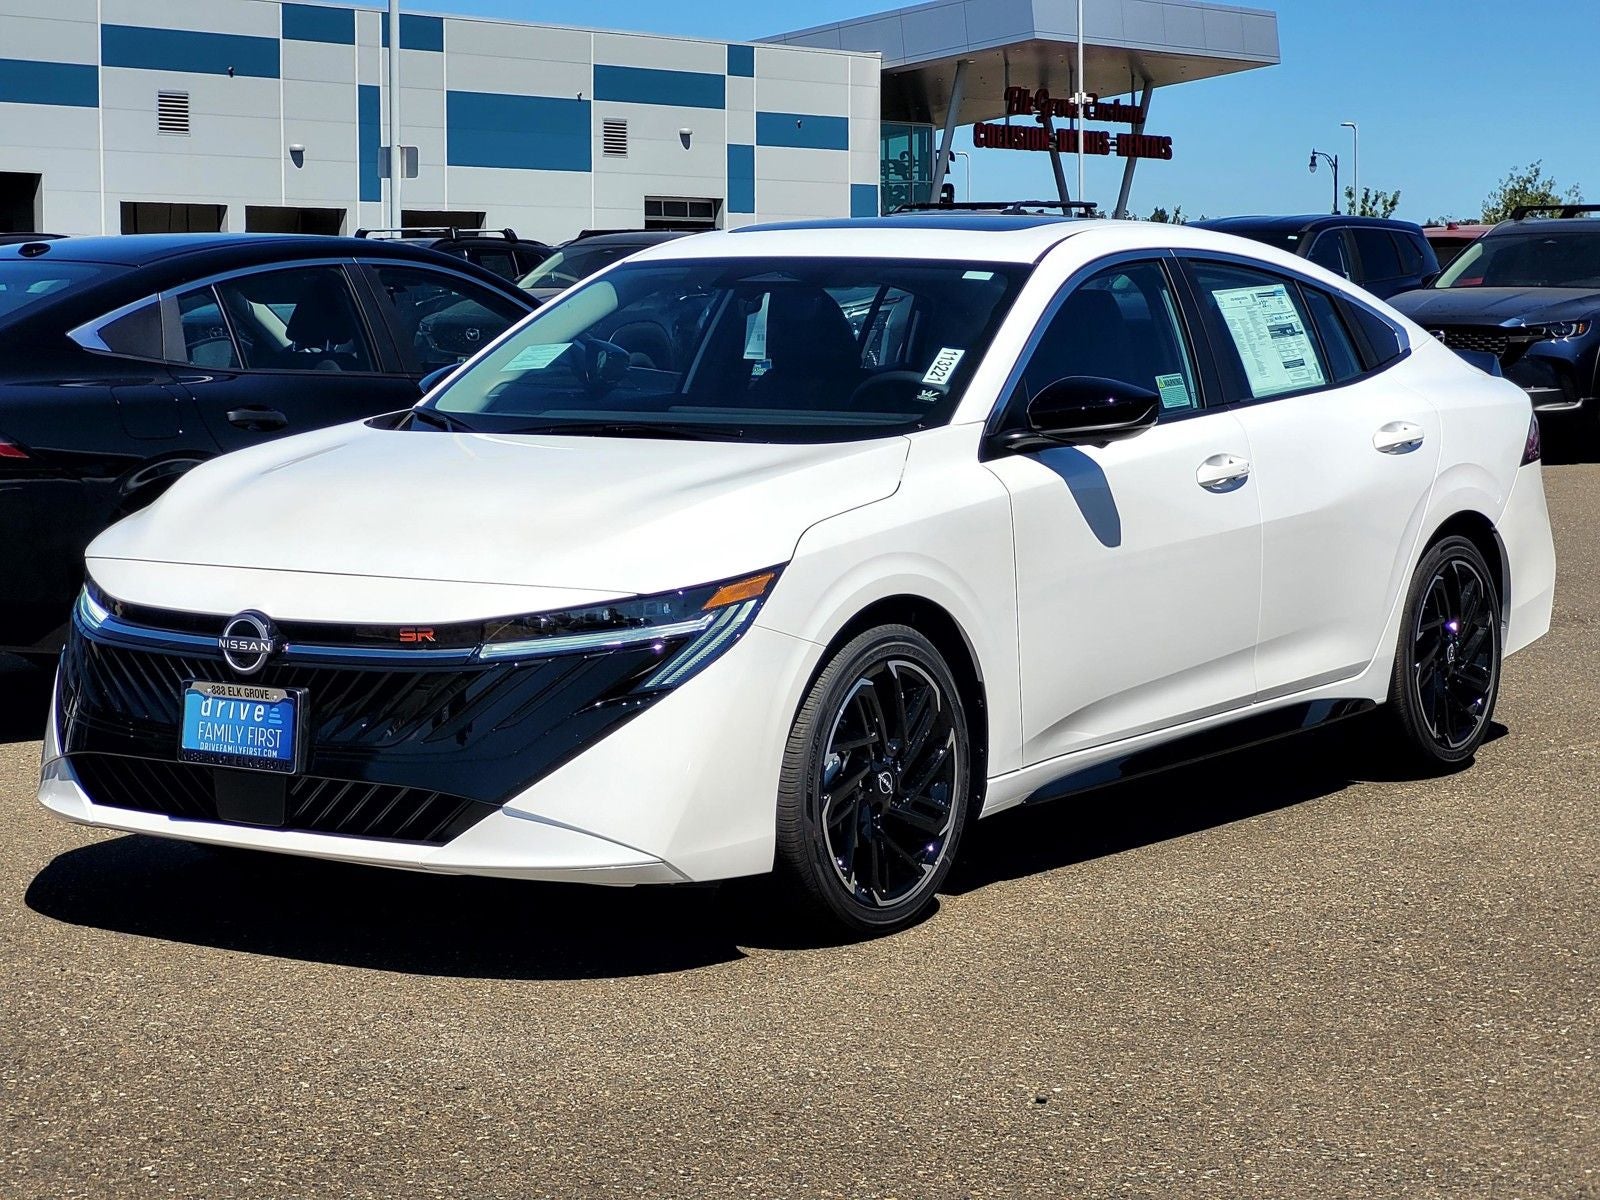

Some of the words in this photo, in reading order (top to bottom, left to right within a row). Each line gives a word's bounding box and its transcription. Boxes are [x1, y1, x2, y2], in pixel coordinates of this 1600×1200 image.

[927, 351, 959, 382] 113221
[399, 627, 436, 642] SR
[218, 638, 271, 652] NISSAN
[227, 686, 242, 698] ELK
[244, 688, 270, 700] GROVE
[201, 697, 265, 722] drive
[198, 721, 245, 744] FAMILY
[247, 726, 283, 749] FIRST
[199, 742, 278, 759] DRIVEFAMILYFIRST.COM
